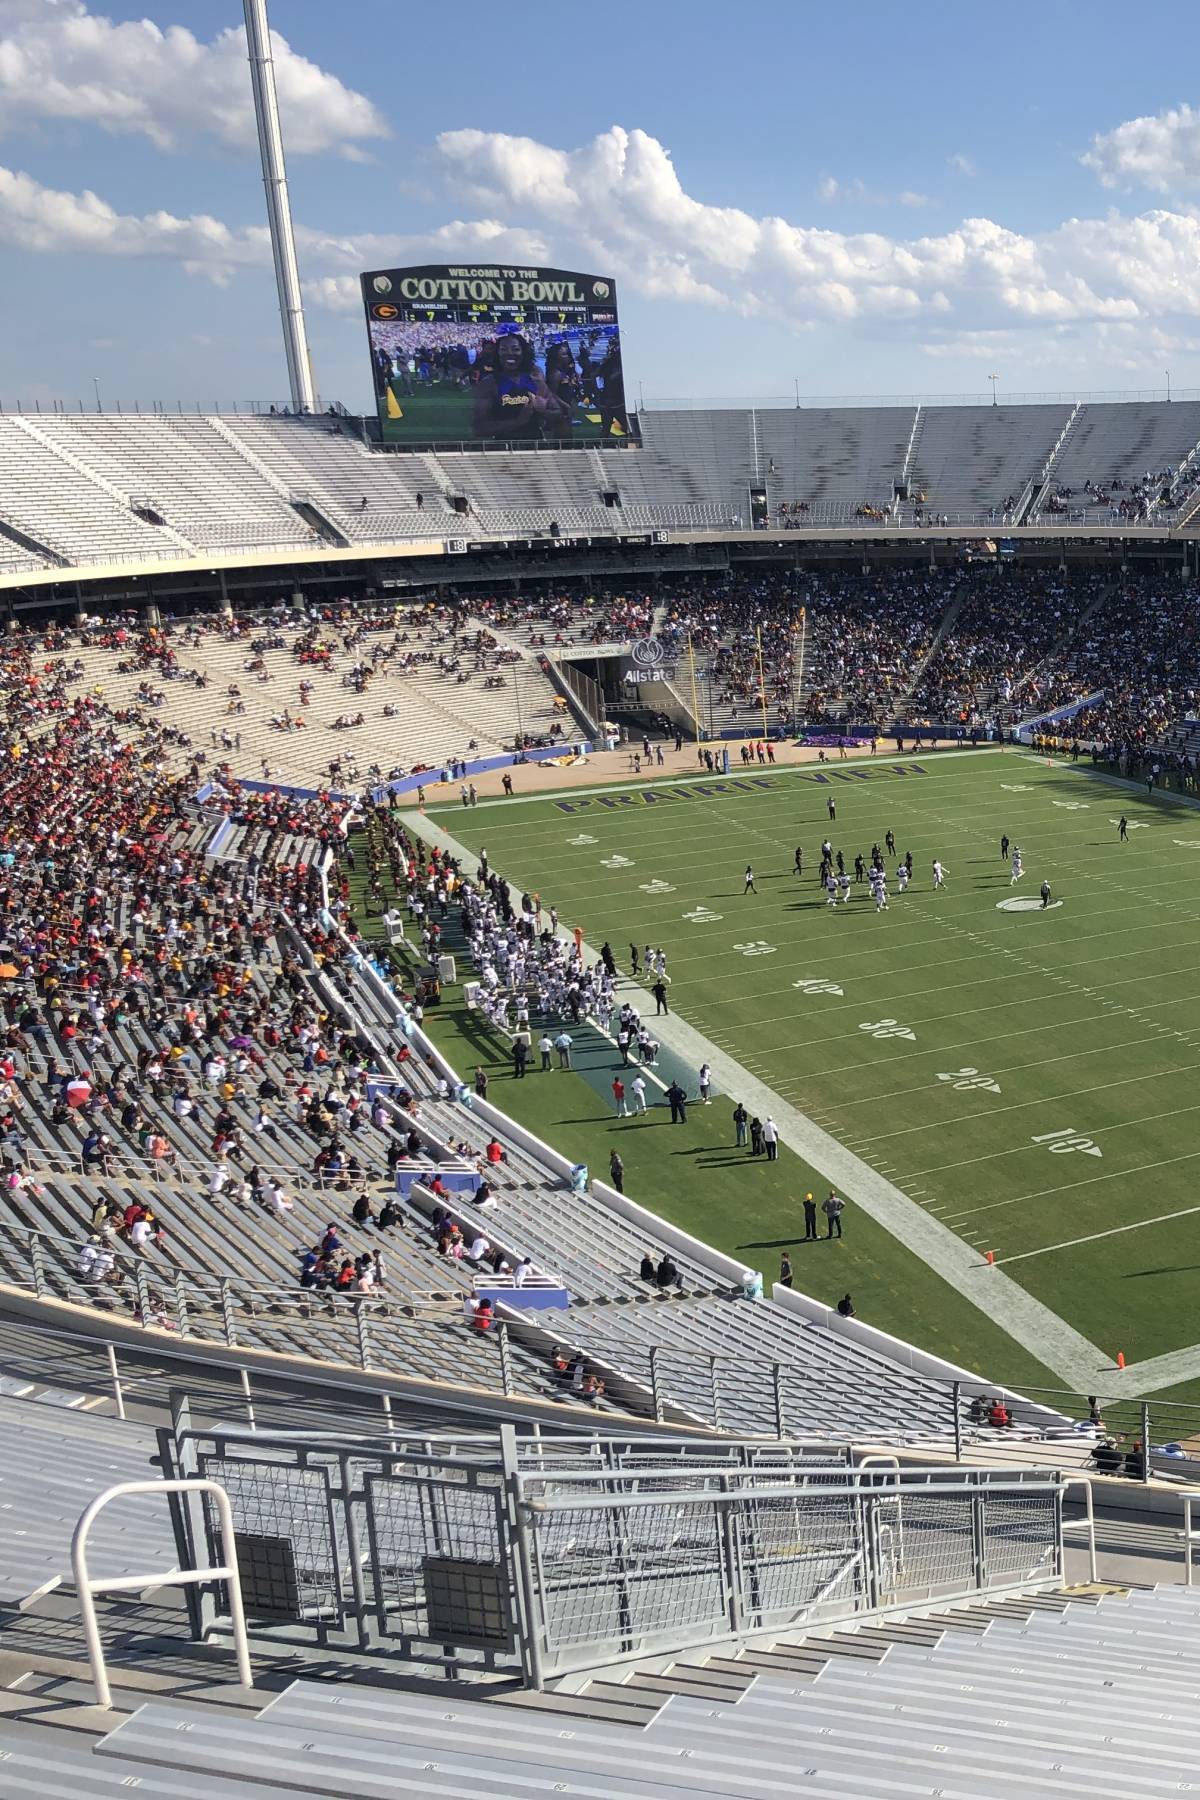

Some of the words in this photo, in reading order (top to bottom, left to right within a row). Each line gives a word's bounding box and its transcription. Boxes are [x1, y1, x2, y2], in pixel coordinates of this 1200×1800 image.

[448, 268, 500, 278] WELCOME
[502, 270, 516, 278] TO
[518, 270, 538, 279] THE
[401, 278, 506, 301] COTTON
[510, 281, 585, 302] BOWL
[624, 668, 673, 683] Allstate
[552, 776, 791, 814] PRAIRIE
[793, 764, 929, 784] VIEW
[732, 940, 778, 956] 50
[792, 978, 841, 995] 40
[858, 1018, 912, 1039] 30
[935, 1067, 995, 1090] 20
[1031, 1128, 1094, 1154] 10
